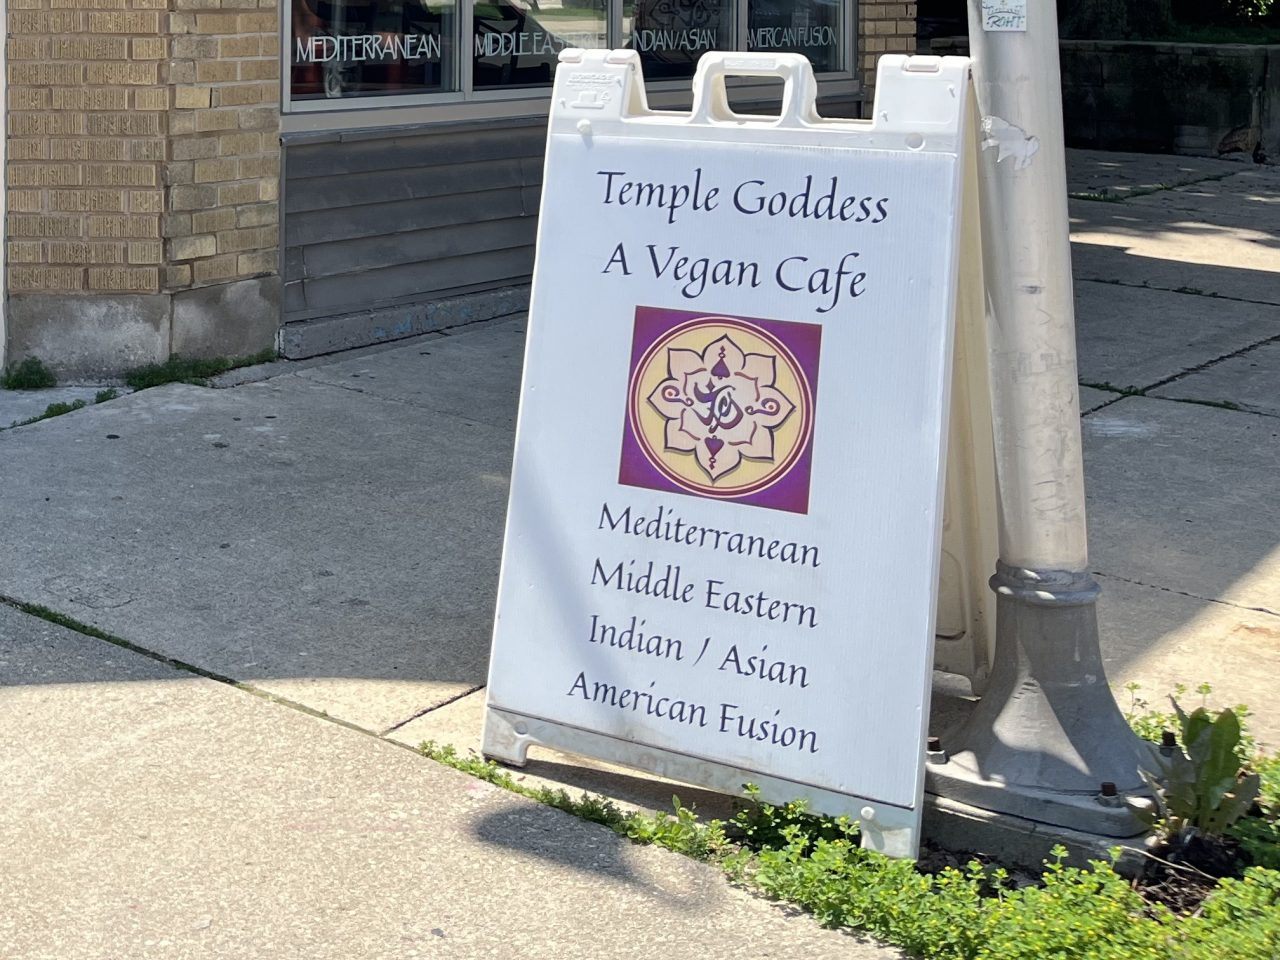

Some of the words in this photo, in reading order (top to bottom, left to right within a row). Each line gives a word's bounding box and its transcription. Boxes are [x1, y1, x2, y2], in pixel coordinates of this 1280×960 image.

[296, 33, 441, 62] MEDITERRANEAN
[474, 31, 531, 57] MIDDLE
[798, 25, 837, 47] FUSION
[596, 168, 719, 224] Temple
[733, 175, 890, 224] Goddess
[601, 242, 632, 276] A
[645, 244, 761, 298] Vegan
[775, 252, 867, 313] Cafe
[597, 502, 822, 568] Mediterranean
[590, 557, 694, 604] Middle
[705, 579, 819, 629] Eastern
[589, 614, 683, 662] Indian
[693, 637, 711, 667] /
[717, 644, 810, 688] Asian
[566, 670, 707, 728] American
[718, 702, 820, 754] Fusion
